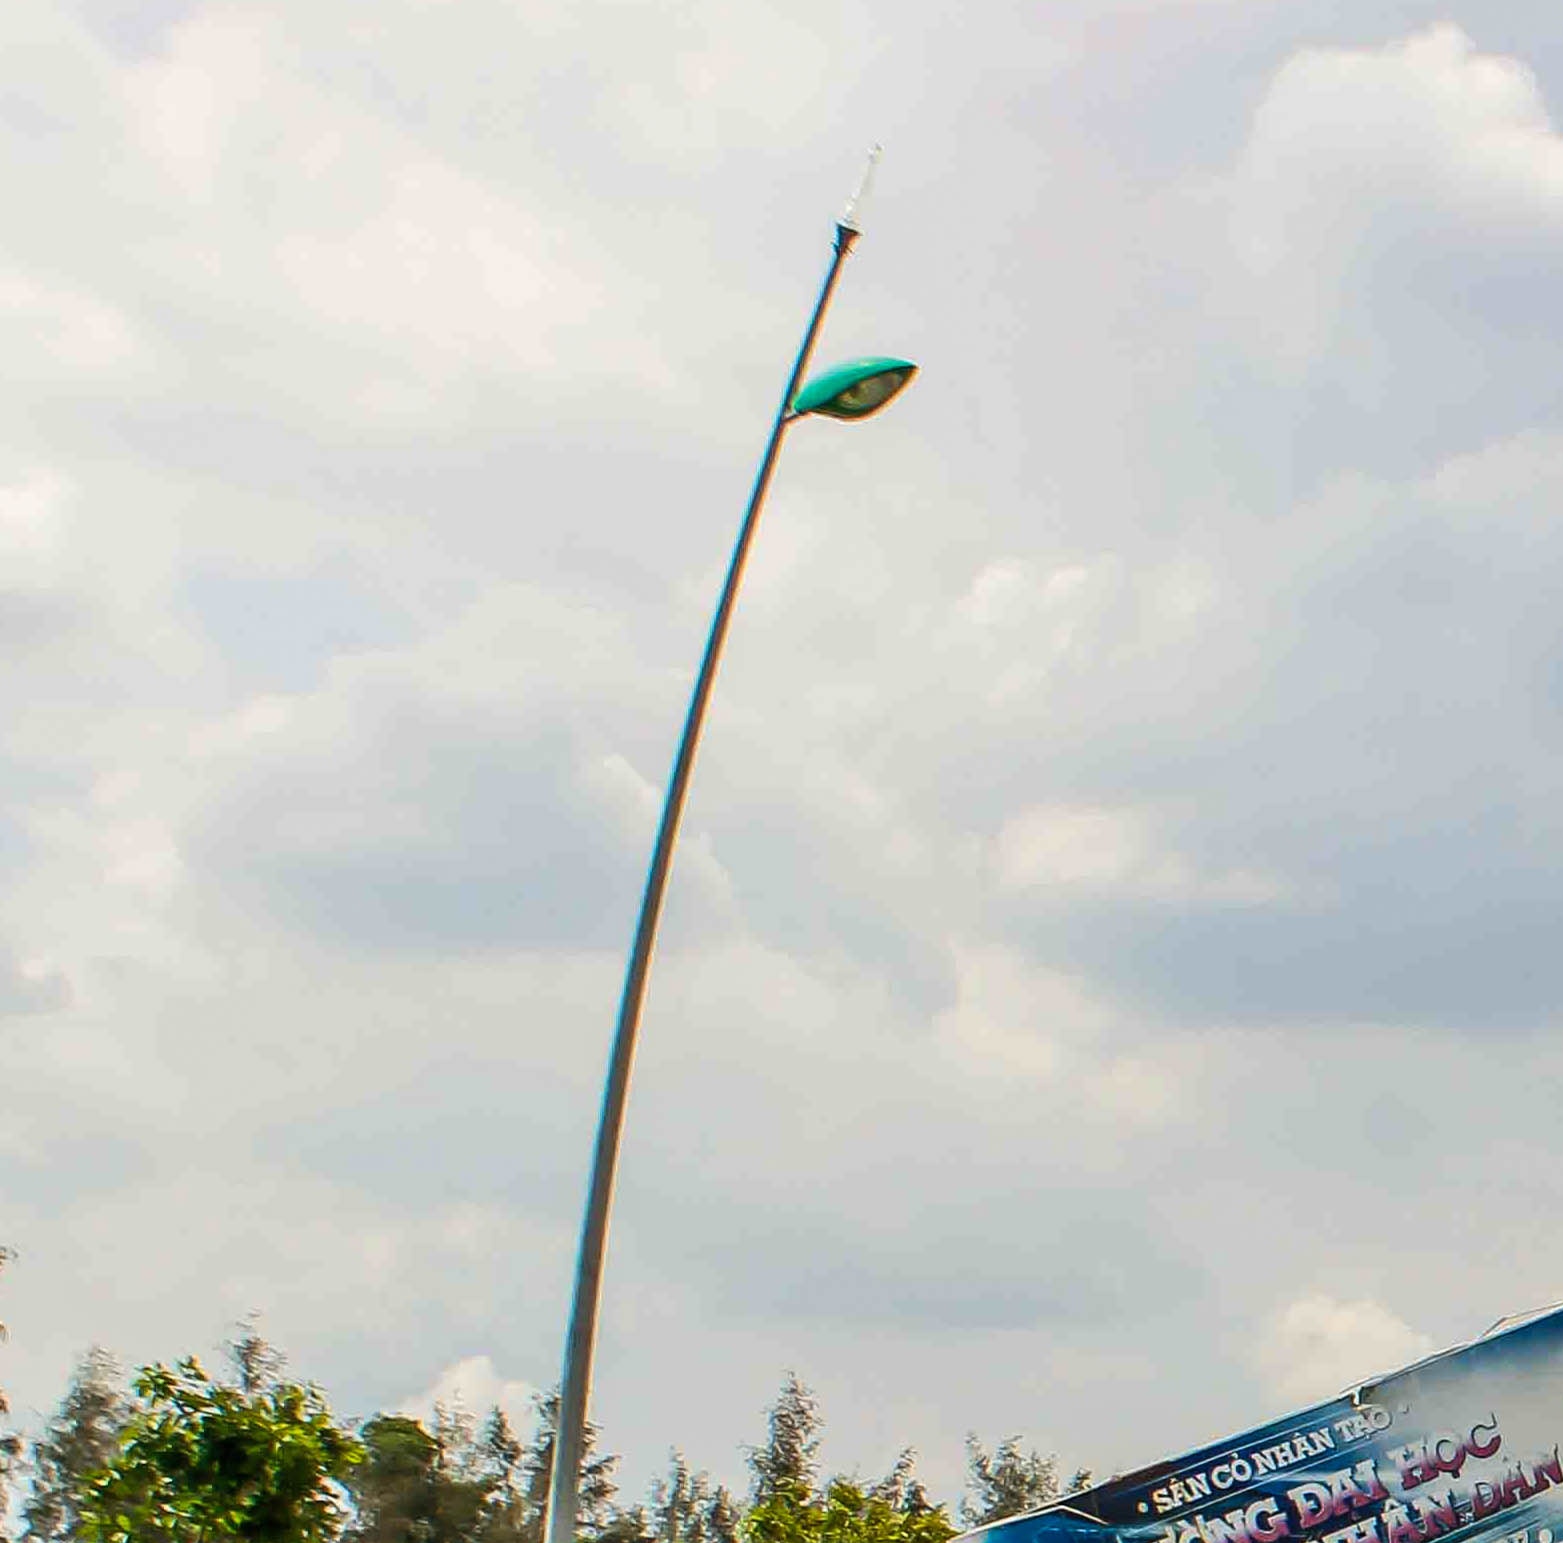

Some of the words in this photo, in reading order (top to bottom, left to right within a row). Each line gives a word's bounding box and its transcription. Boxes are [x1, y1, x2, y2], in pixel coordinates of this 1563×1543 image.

[1151, 1472, 1214, 1516] SÂN
[1211, 1452, 1253, 1491] CỎ
[1251, 1427, 1336, 1475] NHÂN
[1335, 1403, 1393, 1443] TẠO
[1387, 1402, 1503, 1491] HỌC
